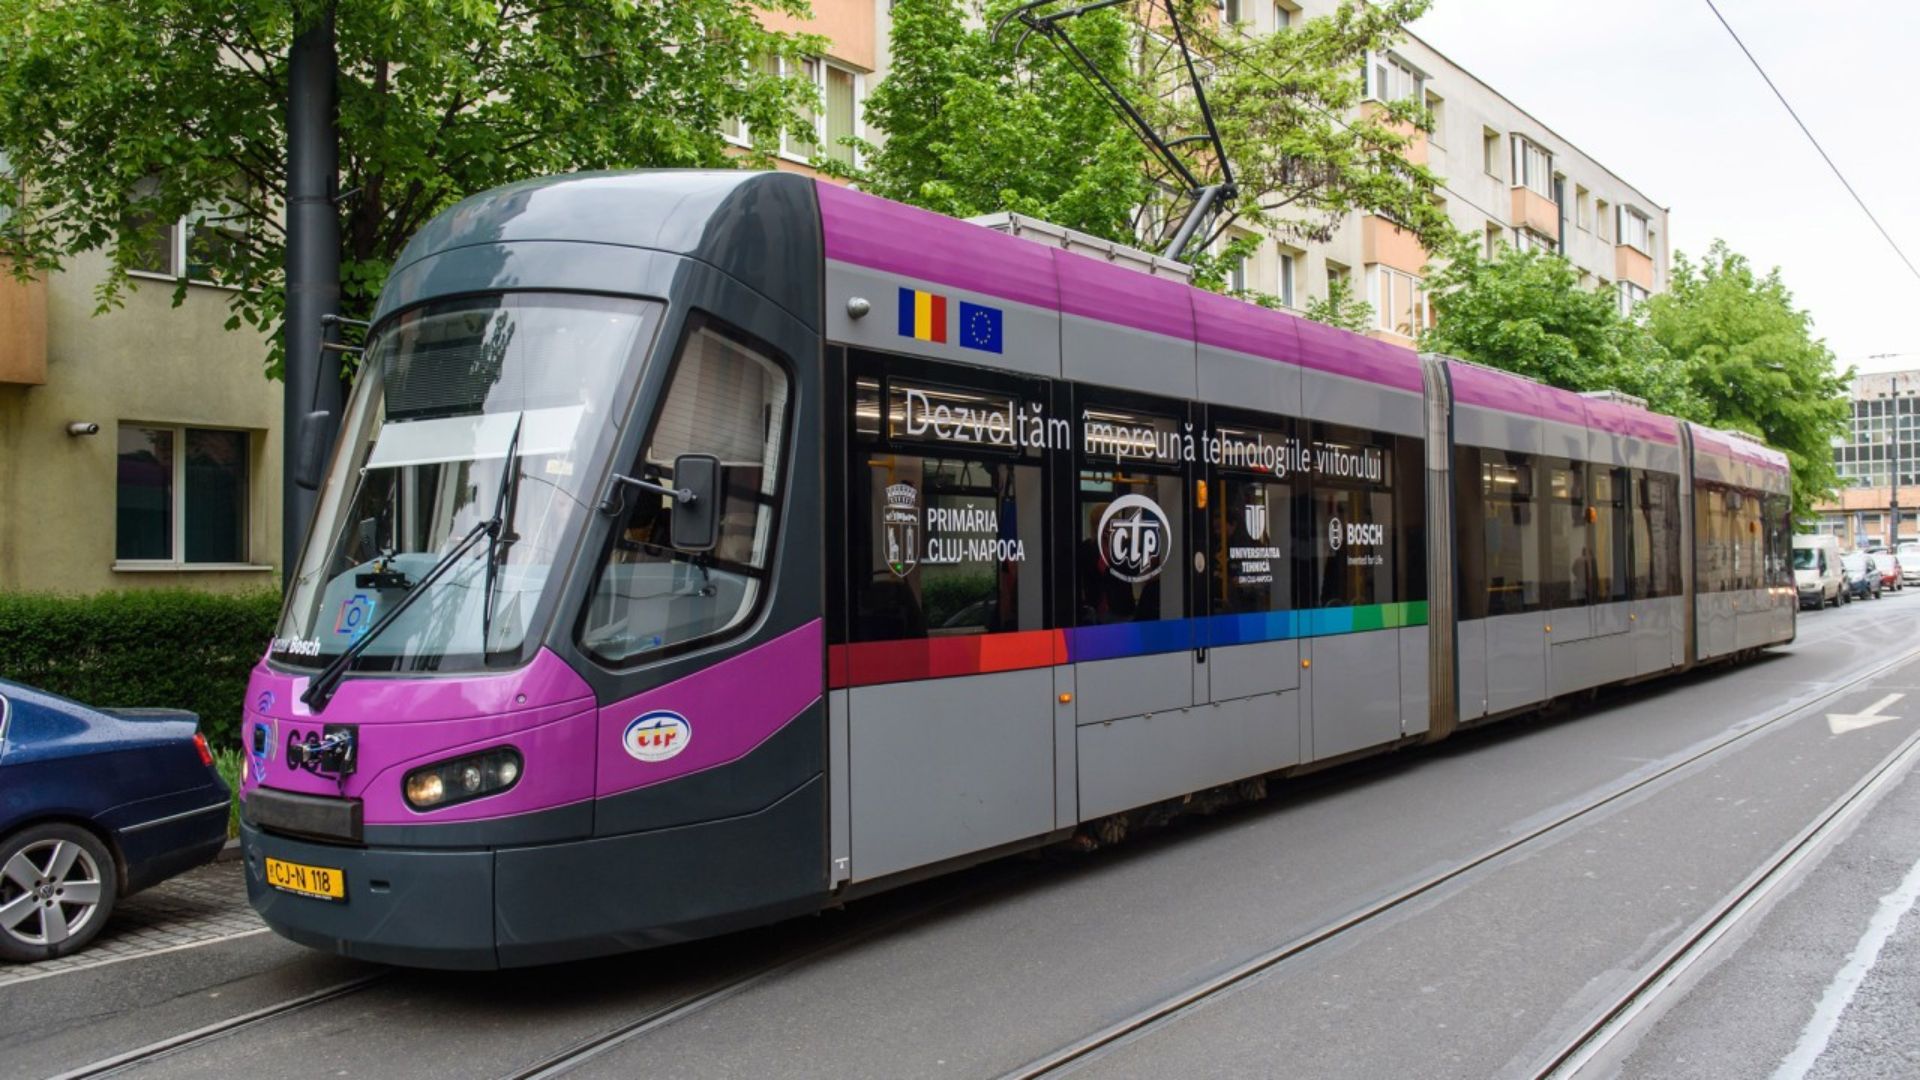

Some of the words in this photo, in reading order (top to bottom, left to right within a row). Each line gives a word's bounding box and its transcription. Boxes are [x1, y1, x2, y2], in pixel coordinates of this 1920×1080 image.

[906, 389, 1070, 450] Dezvoltăm
[1083, 409, 1196, 465] împreună
[1201, 429, 1311, 478] tehnologiile
[1316, 442, 1381, 480] viitorului
[927, 503, 999, 533] PRIMĂRIA
[1346, 523, 1383, 545] BOSCH
[927, 538, 1026, 563] CLUJ-NAPOCA
[288, 635, 321, 657] Bosch
[275, 862, 307, 889] CJ-N
[311, 869, 331, 893] 118
